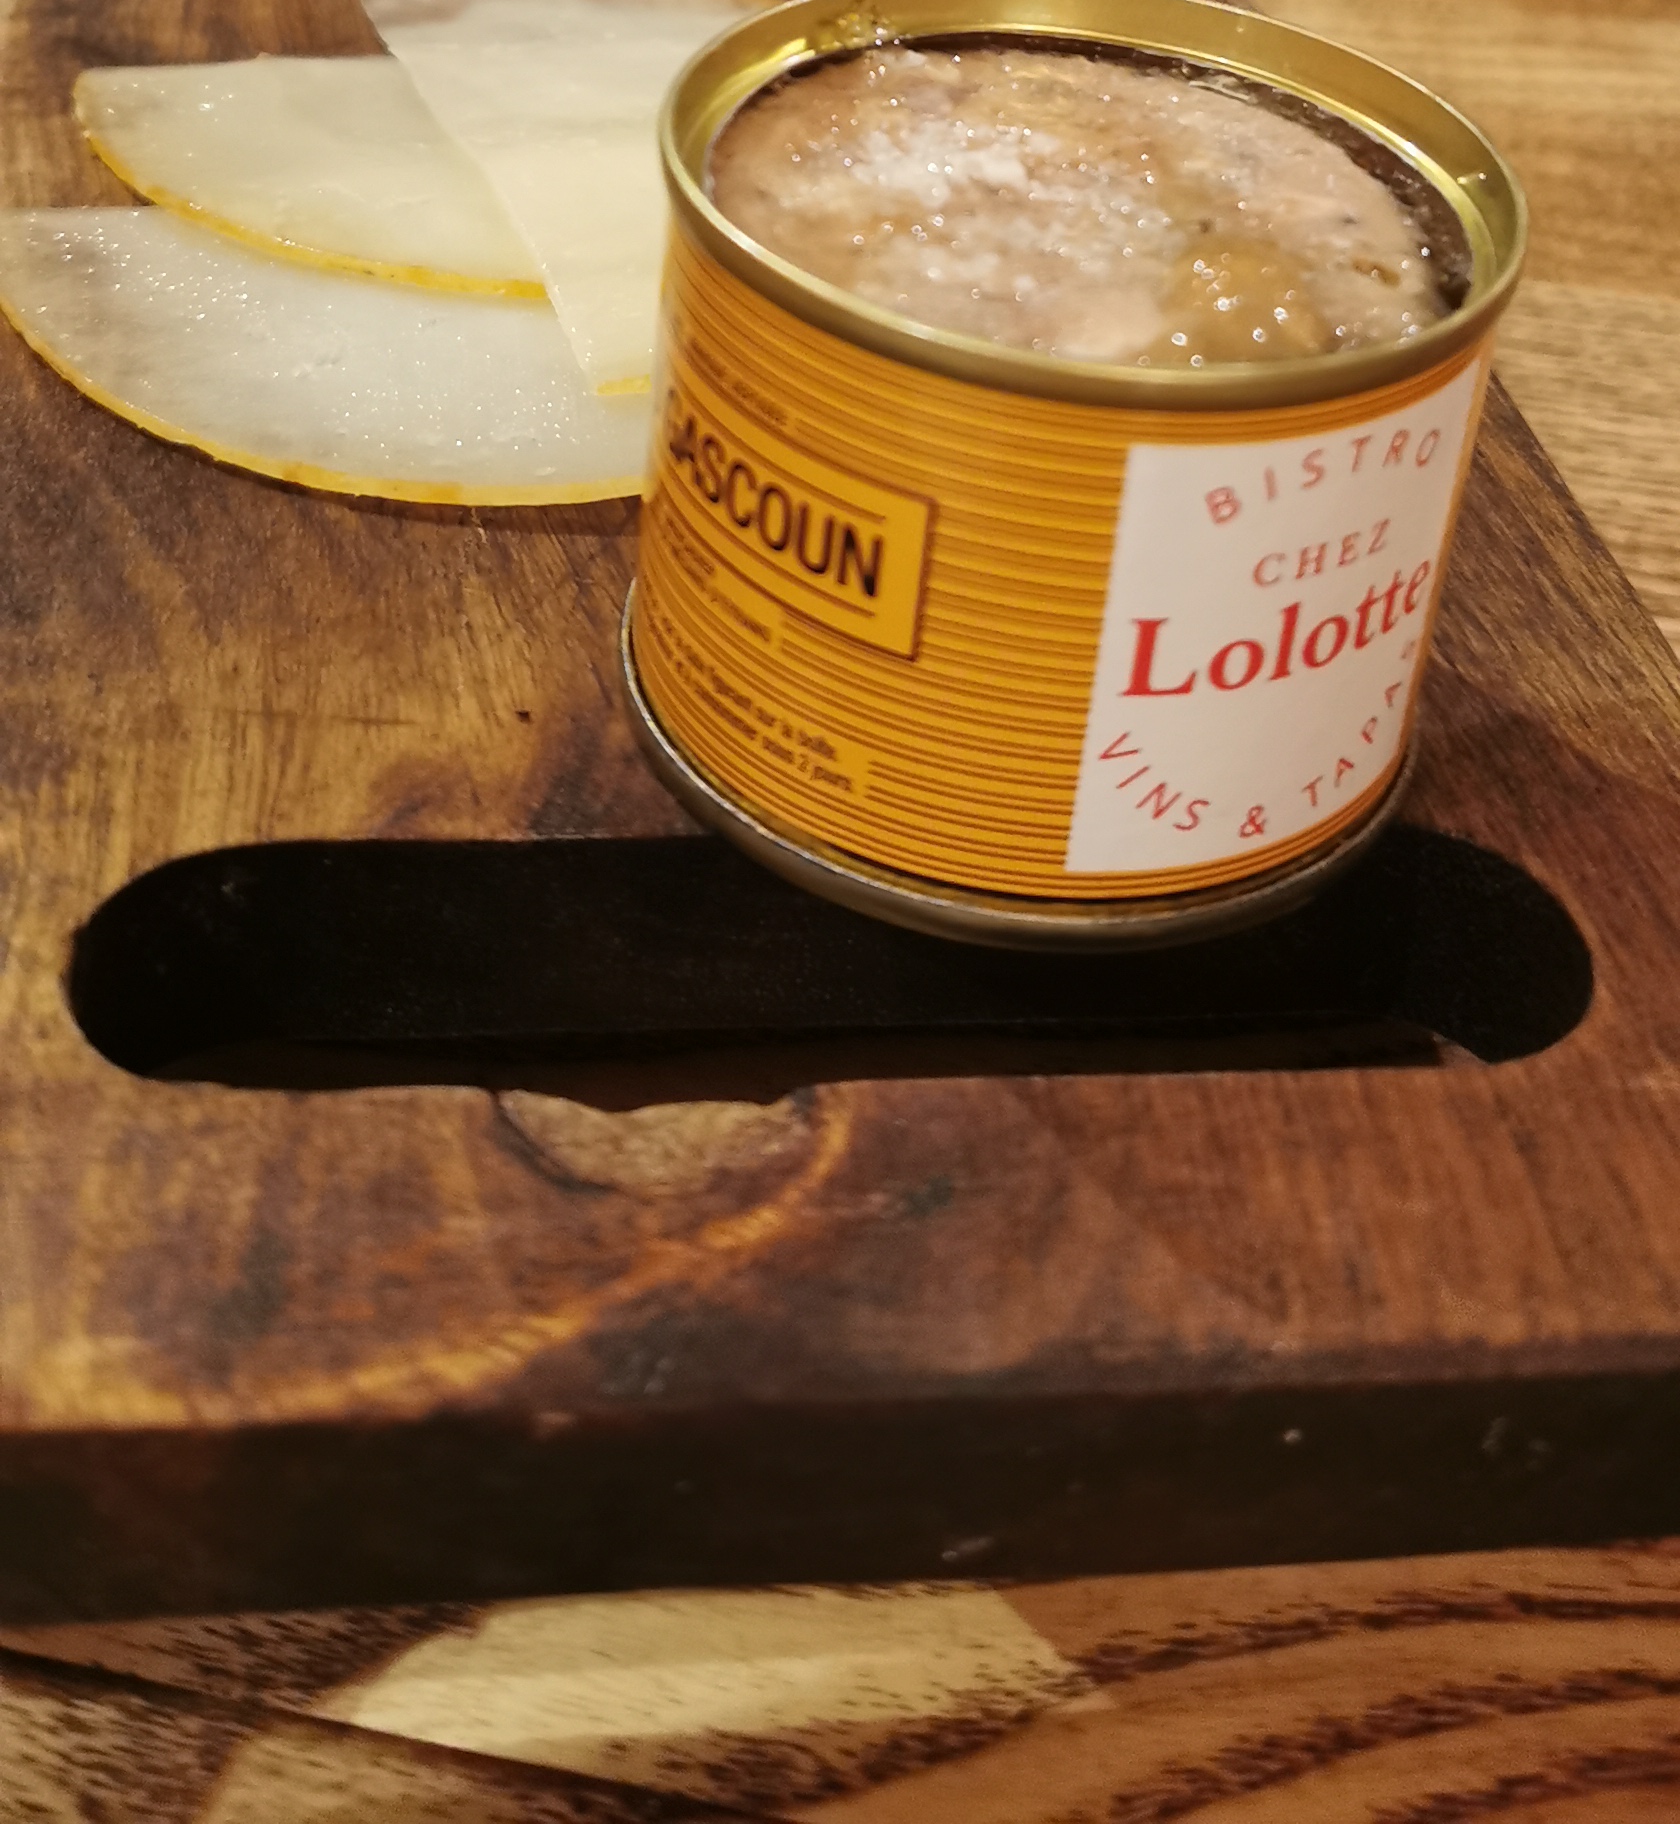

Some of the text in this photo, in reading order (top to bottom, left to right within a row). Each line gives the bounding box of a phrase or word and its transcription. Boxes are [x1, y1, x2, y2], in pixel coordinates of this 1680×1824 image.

[1205, 429, 1441, 524] BISTRO
[1252, 518, 1391, 587] CHEZ
[1119, 560, 1431, 697] Lolotte
[1099, 732, 1210, 832] VINS
[1239, 805, 1267, 838] &
